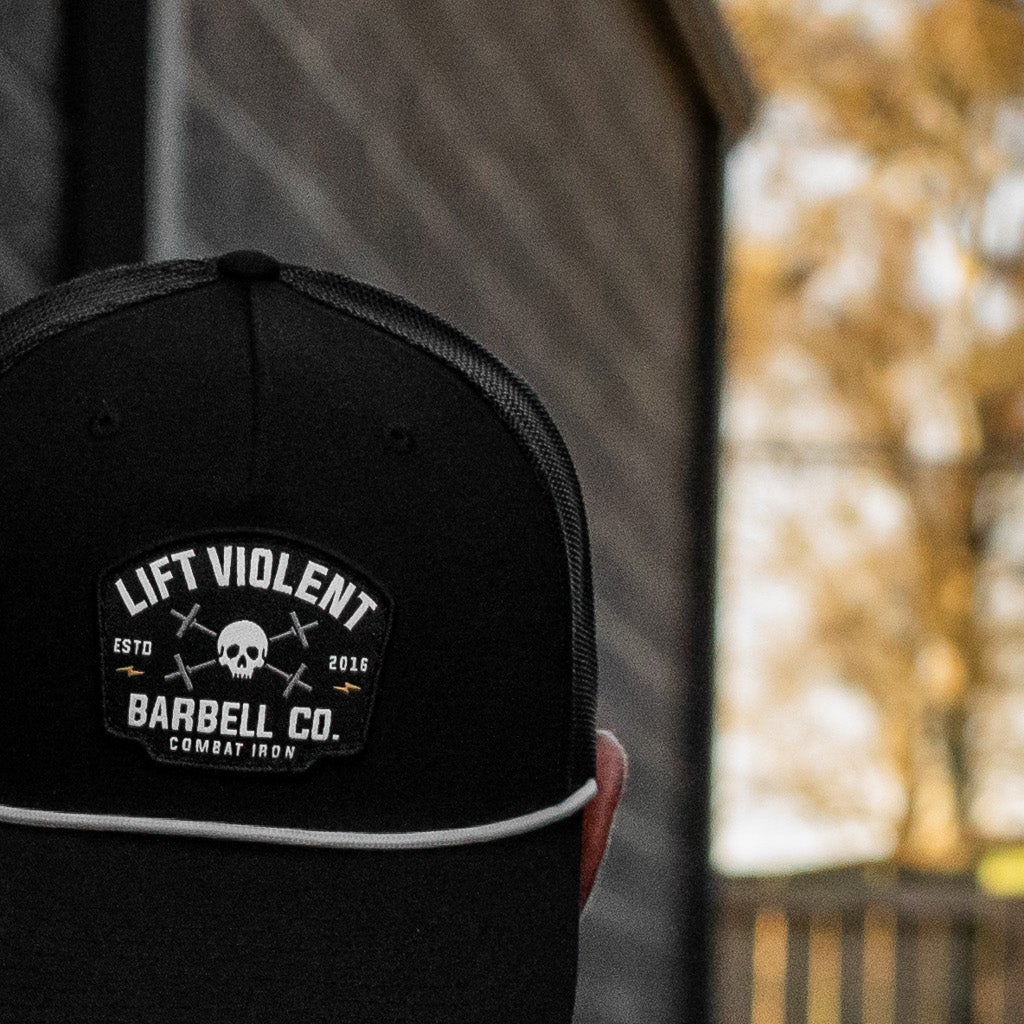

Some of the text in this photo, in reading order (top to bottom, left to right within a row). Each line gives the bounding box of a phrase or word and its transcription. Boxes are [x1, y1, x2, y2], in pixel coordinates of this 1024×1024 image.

[114, 545, 378, 631] LIFT VIOLENT
[113, 637, 152, 656] ESTD
[329, 655, 368, 672] 2016
[128, 693, 340, 741] BARBELL CO.
[169, 737, 295, 759] COMBAT IRON
